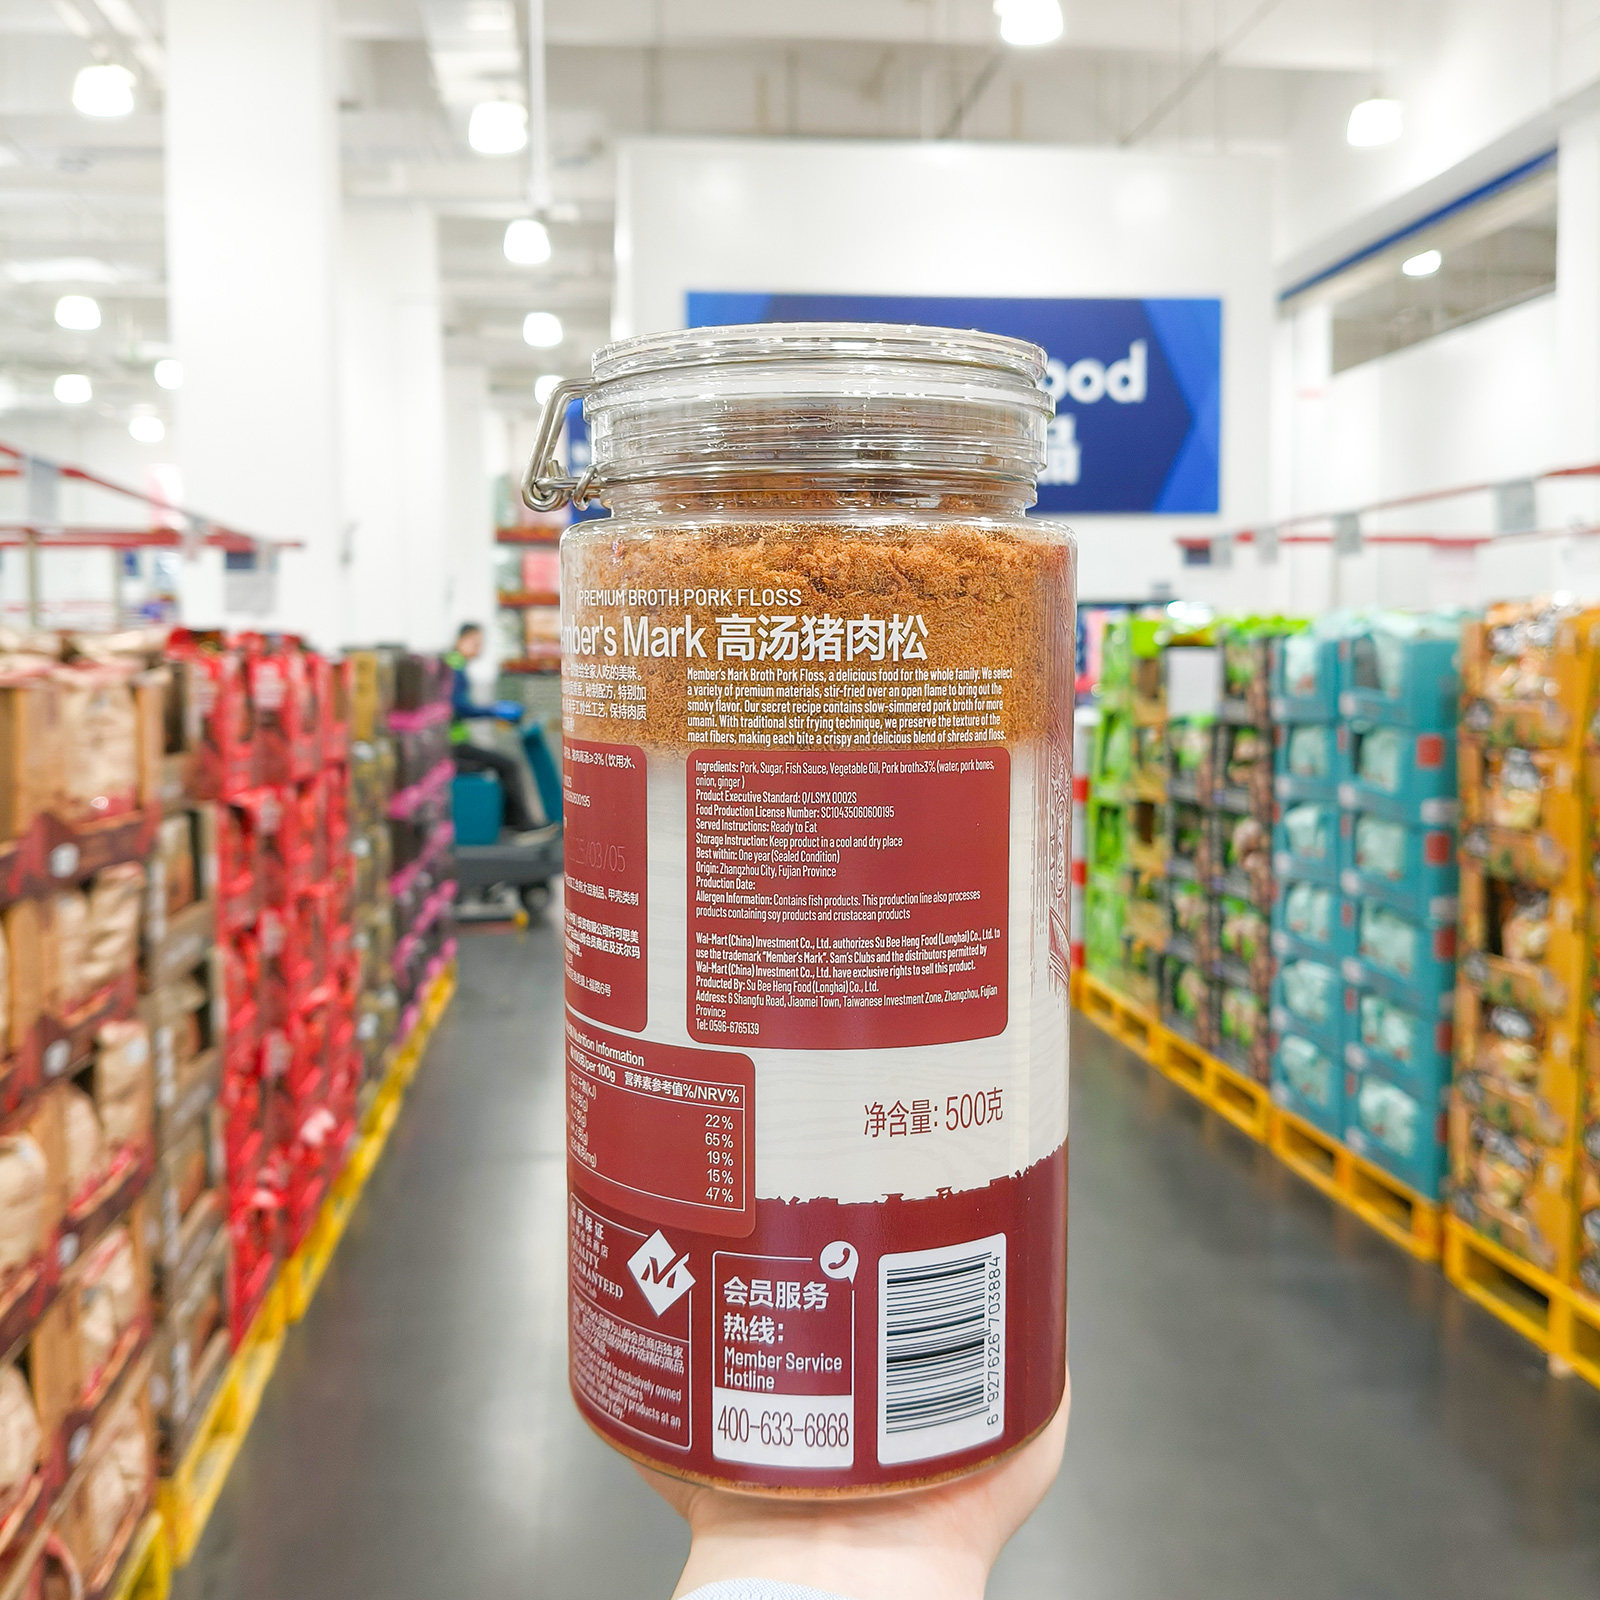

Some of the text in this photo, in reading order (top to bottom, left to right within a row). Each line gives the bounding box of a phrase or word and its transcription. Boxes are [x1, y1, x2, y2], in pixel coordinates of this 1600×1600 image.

[1040, 338, 1147, 403] ood
[579, 588, 802, 607] PREMIUM BROTH PORK FLOSS
[623, 614, 707, 658] Mark
[715, 612, 929, 662] 高汤猪肉松
[687, 667, 1013, 683] Member's Mark Broth Pork Floss, a delicious food for the whole family. We select
[687, 683, 1002, 700] a variety of premium materials, stir-fried over an open flame to bring out the
[687, 699, 1003, 715] smoky flavor. Our secret recipe contains slow-simmered pork broth for more
[687, 714, 1000, 731] umami. With traditional stir frying technique, we preserve the texture of the
[687, 729, 1006, 747] meat fibers, making each bite a crispy and delicious blend of shreds and floss.
[696, 789, 724, 801] Product
[725, 790, 761, 803] Executive
[763, 791, 801, 803] Standard:
[832, 792, 857, 803] 0002S
[696, 804, 894, 818] Food Production License Number: SC10435060600195
[696, 818, 817, 836] Served Instructions: Ready to Eat
[696, 833, 903, 850] Storage Instruction: Keep product in a cool and dry place
[696, 847, 840, 864] Best within: One year (Sealed Condition)
[696, 862, 836, 879] Origin: Zhangzhou City, Fujian Province
[696, 876, 755, 890] Production Date:
[696, 1018, 759, 1034] Tel: 0596-6765139
[595, 1041, 645, 1067] Information
[597, 1062, 616, 1083] 100g
[945, 1086, 1004, 1131] 500克
[723, 1276, 830, 1310] 会员服务
[724, 1346, 842, 1372] Member Service
[724, 1366, 775, 1391] Hotline
[717, 1405, 849, 1447] 400-633-6868
